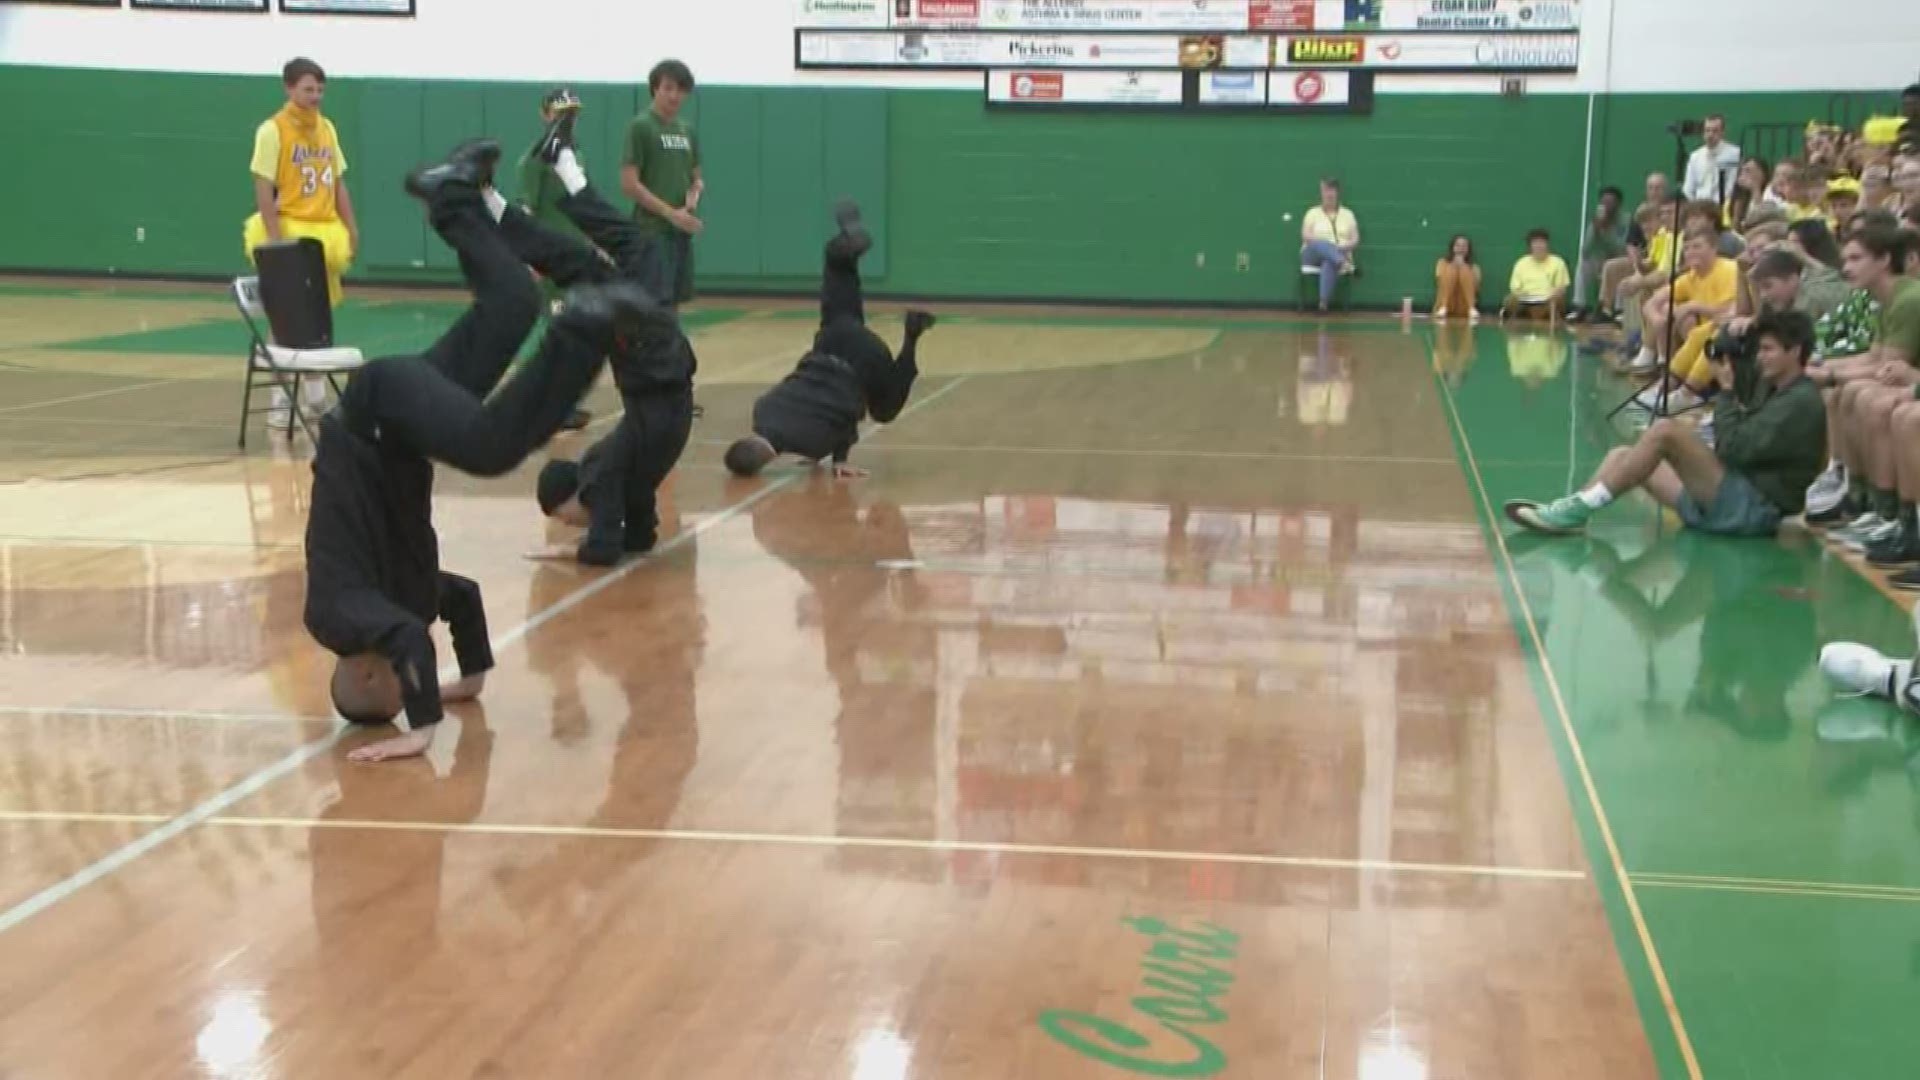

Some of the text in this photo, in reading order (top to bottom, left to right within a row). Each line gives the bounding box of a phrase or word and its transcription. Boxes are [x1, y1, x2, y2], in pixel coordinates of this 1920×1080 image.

[1104, 9, 1142, 20] CENTER
[1454, 16, 1490, 28] Center
[1009, 41, 1075, 57] Pickering
[1294, 38, 1359, 60] Pilot
[300, 165, 334, 195] 34
